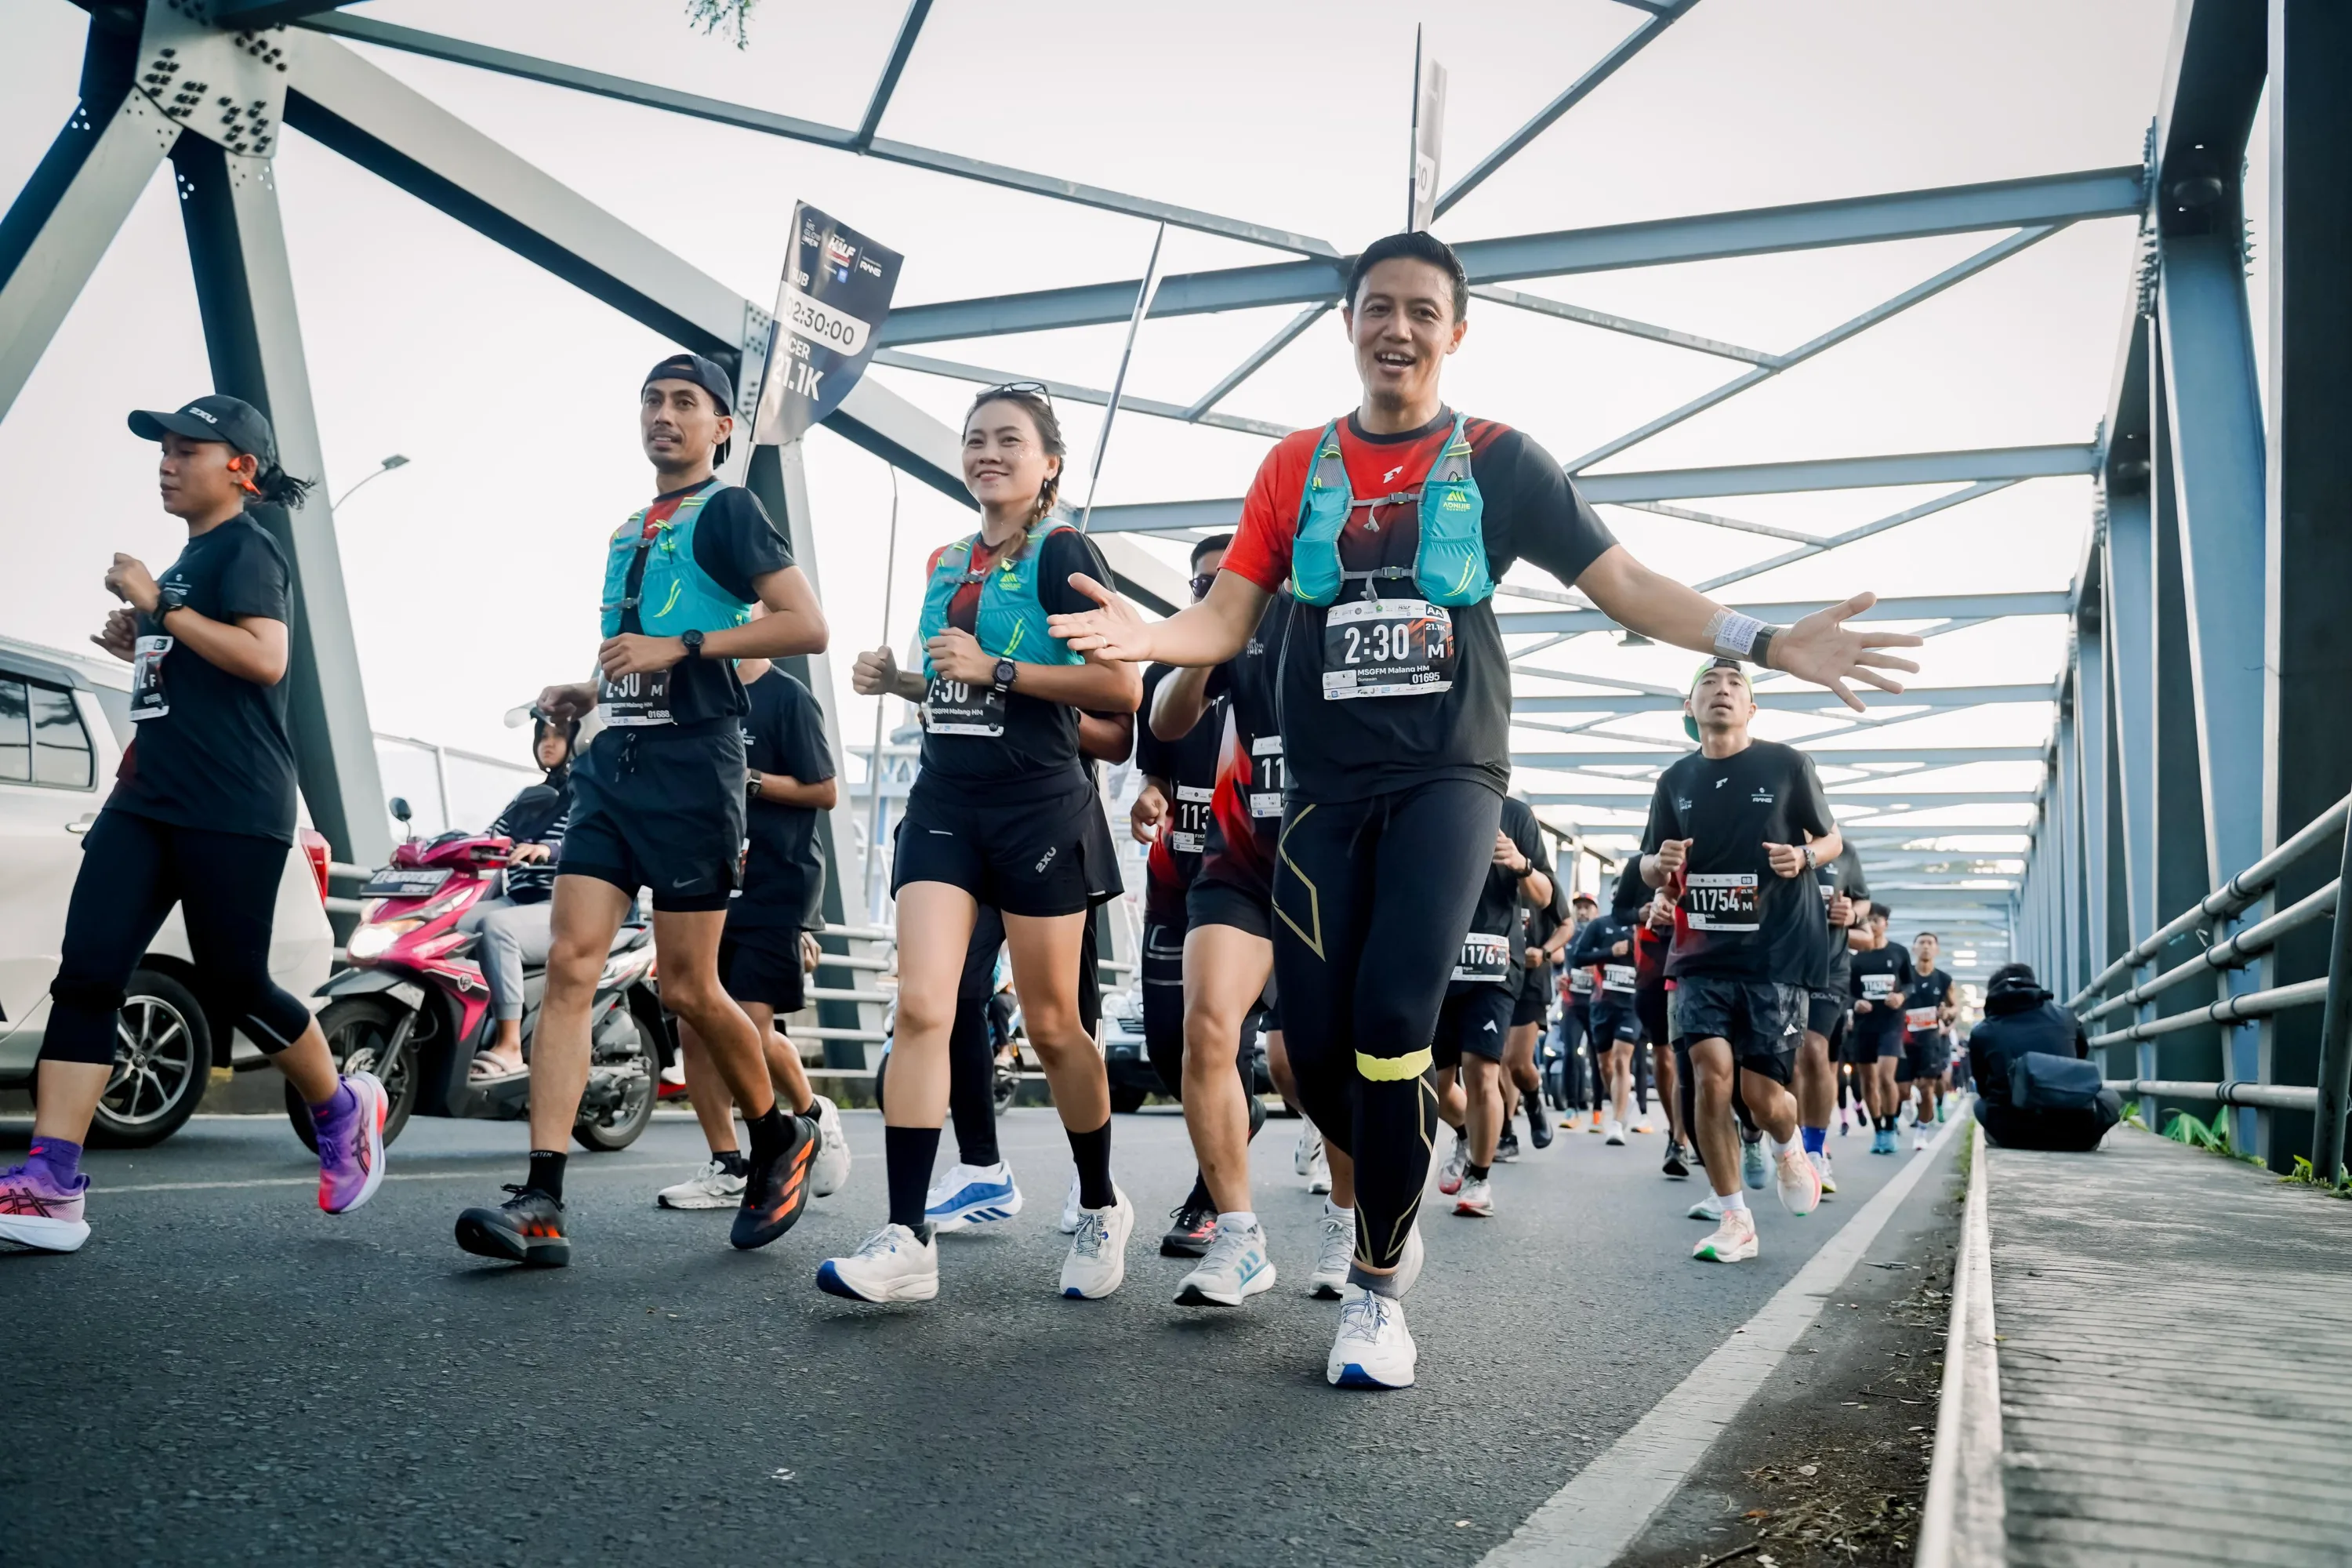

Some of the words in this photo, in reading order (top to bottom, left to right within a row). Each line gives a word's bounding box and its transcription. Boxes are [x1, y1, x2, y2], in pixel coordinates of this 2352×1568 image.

[791, 267, 810, 287] SUB
[786, 296, 855, 345] 02:30:00
[773, 350, 825, 401] 21.1K
[188, 407, 219, 424] 2XU
[1426, 606, 1443, 618] AA
[1425, 622, 1446, 633] 21.1K
[1344, 624, 1410, 665] 2:30
[1428, 644, 1445, 659] M
[1357, 667, 1387, 676] MSGFM
[1412, 672, 1441, 684] 01695
[149, 674, 157, 688] F
[651, 684, 663, 696] M
[985, 691, 996, 705] F
[1035, 846, 1058, 873] 2XU
[1690, 888, 1740, 911] 11754
[1742, 902, 1753, 911] M
[1497, 956, 1507, 966] M
